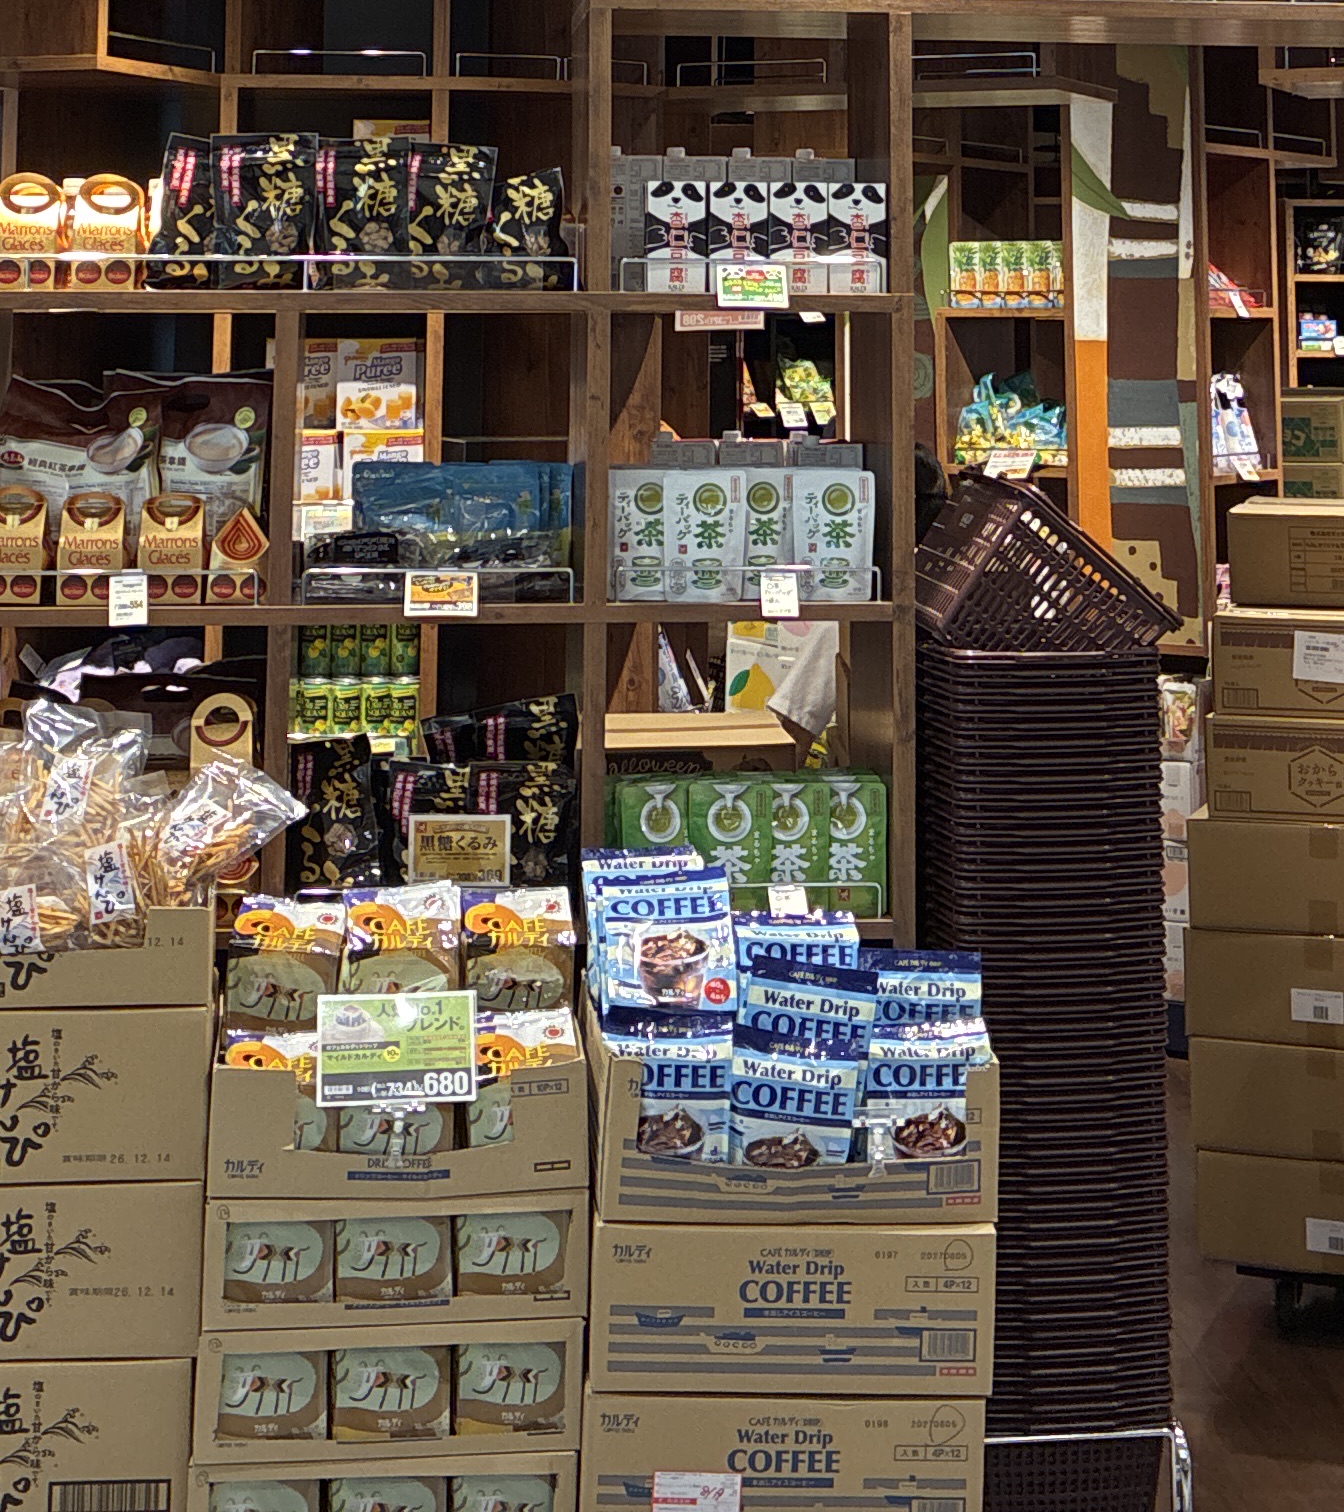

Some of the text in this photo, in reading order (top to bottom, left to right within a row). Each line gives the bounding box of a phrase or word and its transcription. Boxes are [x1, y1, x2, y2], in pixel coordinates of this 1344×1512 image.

[259, 134, 305, 216] 黒糖
[353, 137, 397, 217] 黒糖
[436, 146, 480, 226] 黒糖
[669, 211, 686, 283] 杏仁豆腐
[731, 212, 747, 261] 杏仁豆
[791, 212, 808, 284] 杏仁豆腐
[371, 355, 402, 366] Mango
[676, 492, 693, 540] ティーバッグ
[805, 492, 821, 539] ティーバッグ
[62, 536, 119, 550] Marrons
[142, 535, 199, 550] Marrons
[694, 520, 726, 549] 茶
[748, 517, 781, 547] 茶
[822, 519, 856, 549] 茶
[609, 757, 701, 776] alloween
[419, 835, 498, 852] 黒糖くるみ
[771, 844, 810, 883] 茶
[829, 843, 868, 881] 茶
[94, 851, 126, 913] 塩けんぴ
[169, 937, 183, 947] 14
[252, 934, 316, 952] カルディ
[373, 933, 433, 949] カルディ
[487, 931, 549, 948] カルディ
[927, 982, 967, 1002] Drip
[764, 990, 860, 1021] Water Drip
[424, 1071, 469, 1096] 680
[743, 1060, 842, 1089] Water Drip
[732, 1080, 849, 1116] COFFEE
[224, 1160, 264, 1173] カルディ
[612, 1243, 652, 1258] カルディ
[784, 1248, 811, 1258] カルディ
[749, 1260, 845, 1279] Water Drip
[739, 1280, 852, 1305] COFFEE
[600, 1413, 639, 1427] カルディ
[773, 1417, 800, 1427] カルディ
[737, 1429, 833, 1448] Water Drip
[727, 1450, 840, 1474] COFFEE
